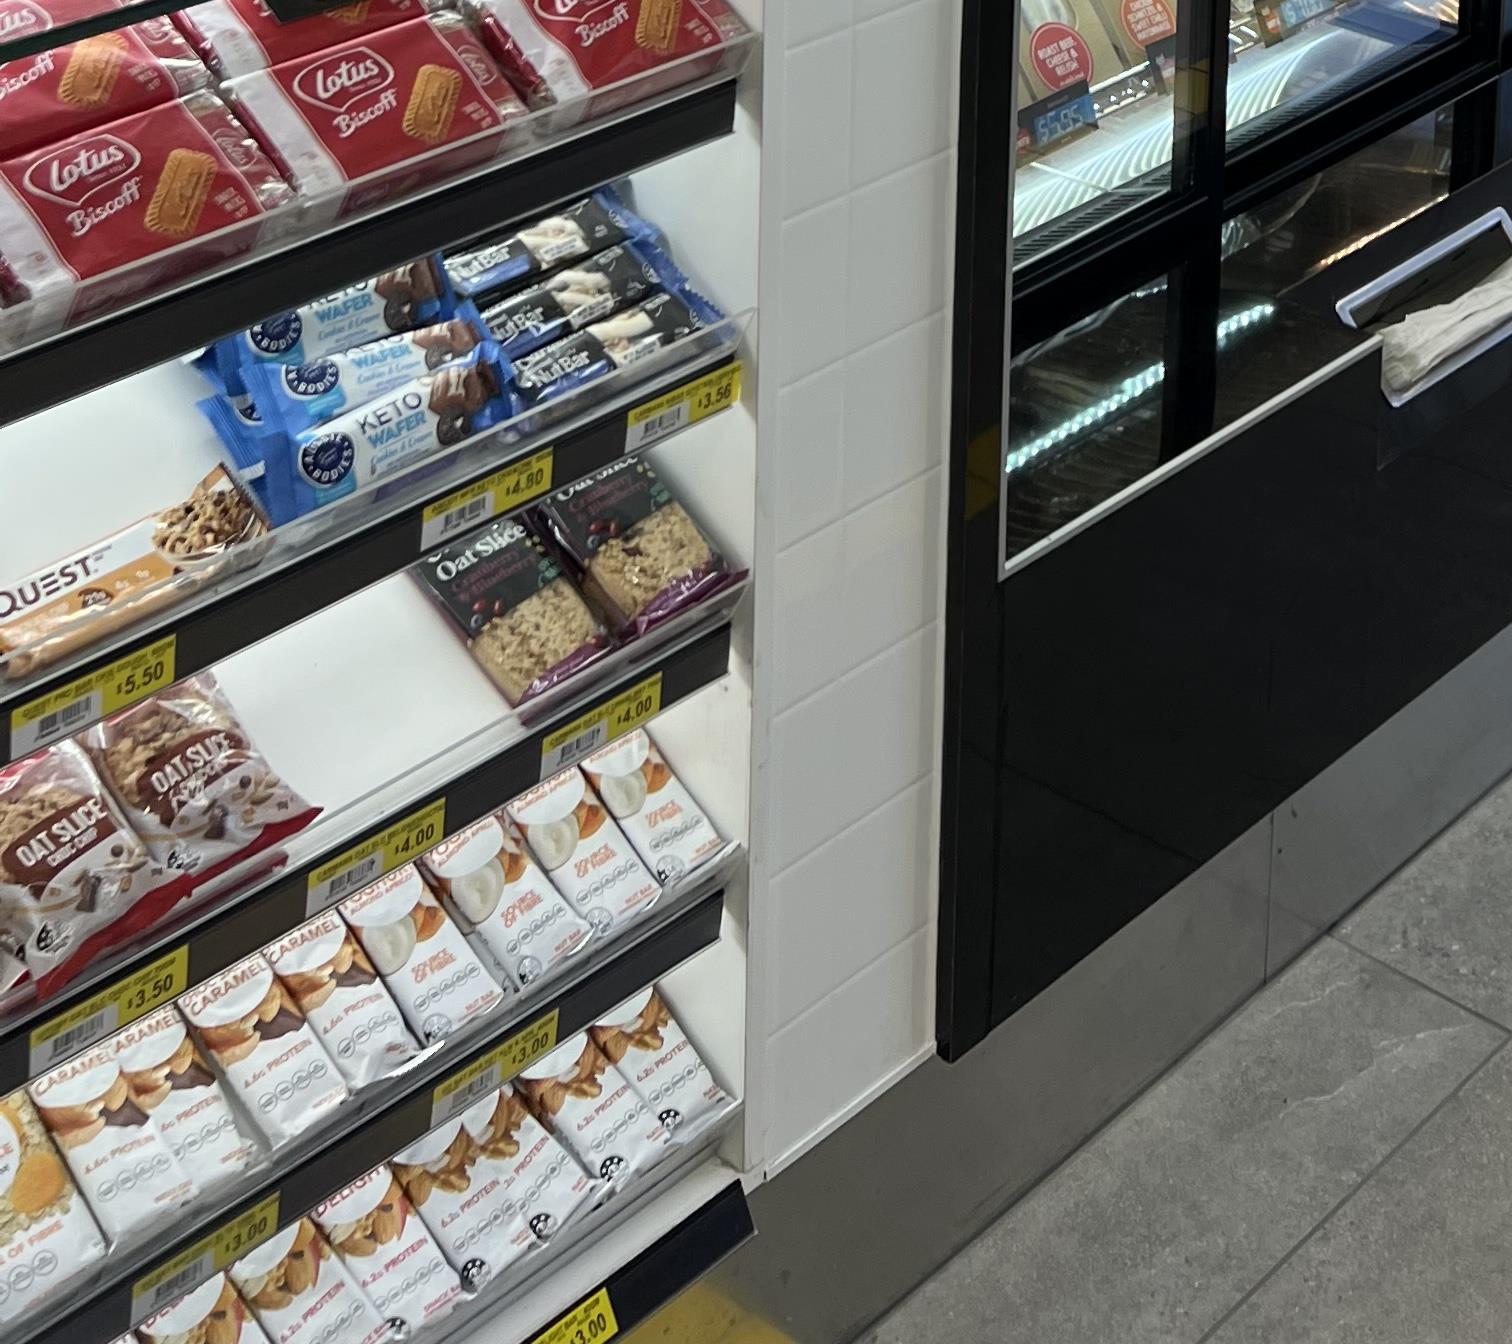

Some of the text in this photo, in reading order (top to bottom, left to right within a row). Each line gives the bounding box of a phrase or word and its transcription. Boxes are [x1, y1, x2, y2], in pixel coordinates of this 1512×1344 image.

[575, 2, 630, 47] Biscoff
[316, 59, 380, 99] Lotus
[332, 88, 399, 138] Biscoff
[50, 143, 126, 193] Lotus
[66, 175, 142, 238] Biscoff
[316, 293, 375, 324] WAFER
[352, 344, 413, 369] WAFER
[565, 350, 590, 369] Bar
[356, 392, 423, 435] KETO
[697, 382, 732, 409] $3.56
[368, 411, 426, 449] WAFER
[505, 467, 545, 497] $4.80
[436, 524, 527, 582] Oat Slice
[0, 555, 92, 619] QUEST
[116, 661, 165, 696] $5.50
[616, 694, 653, 726] $4.00
[151, 730, 235, 794] OAT SLICE
[15, 798, 107, 869] OAT SLICE
[47, 826, 99, 868] CHOC CHIP
[394, 822, 435, 856] $4.00
[268, 918, 341, 965] CARAMEL
[127, 973, 174, 1011] $3.50
[190, 956, 269, 1016] CARAMEL
[266, 1038, 313, 1077] PROTEIN
[512, 1031, 550, 1065] $3.00
[653, 1039, 689, 1073] PROTEIN
[33, 1045, 116, 1096] CARAMEL
[594, 1084, 632, 1118] PROTEIN
[109, 1132, 155, 1161] PROTEIN
[459, 1177, 501, 1215] PROTEIN
[27, 1220, 64, 1246] FIBRE
[224, 1215, 268, 1257] $3.00
[383, 1237, 429, 1276] PROTEIN
[301, 1280, 347, 1324] PROTEIN
